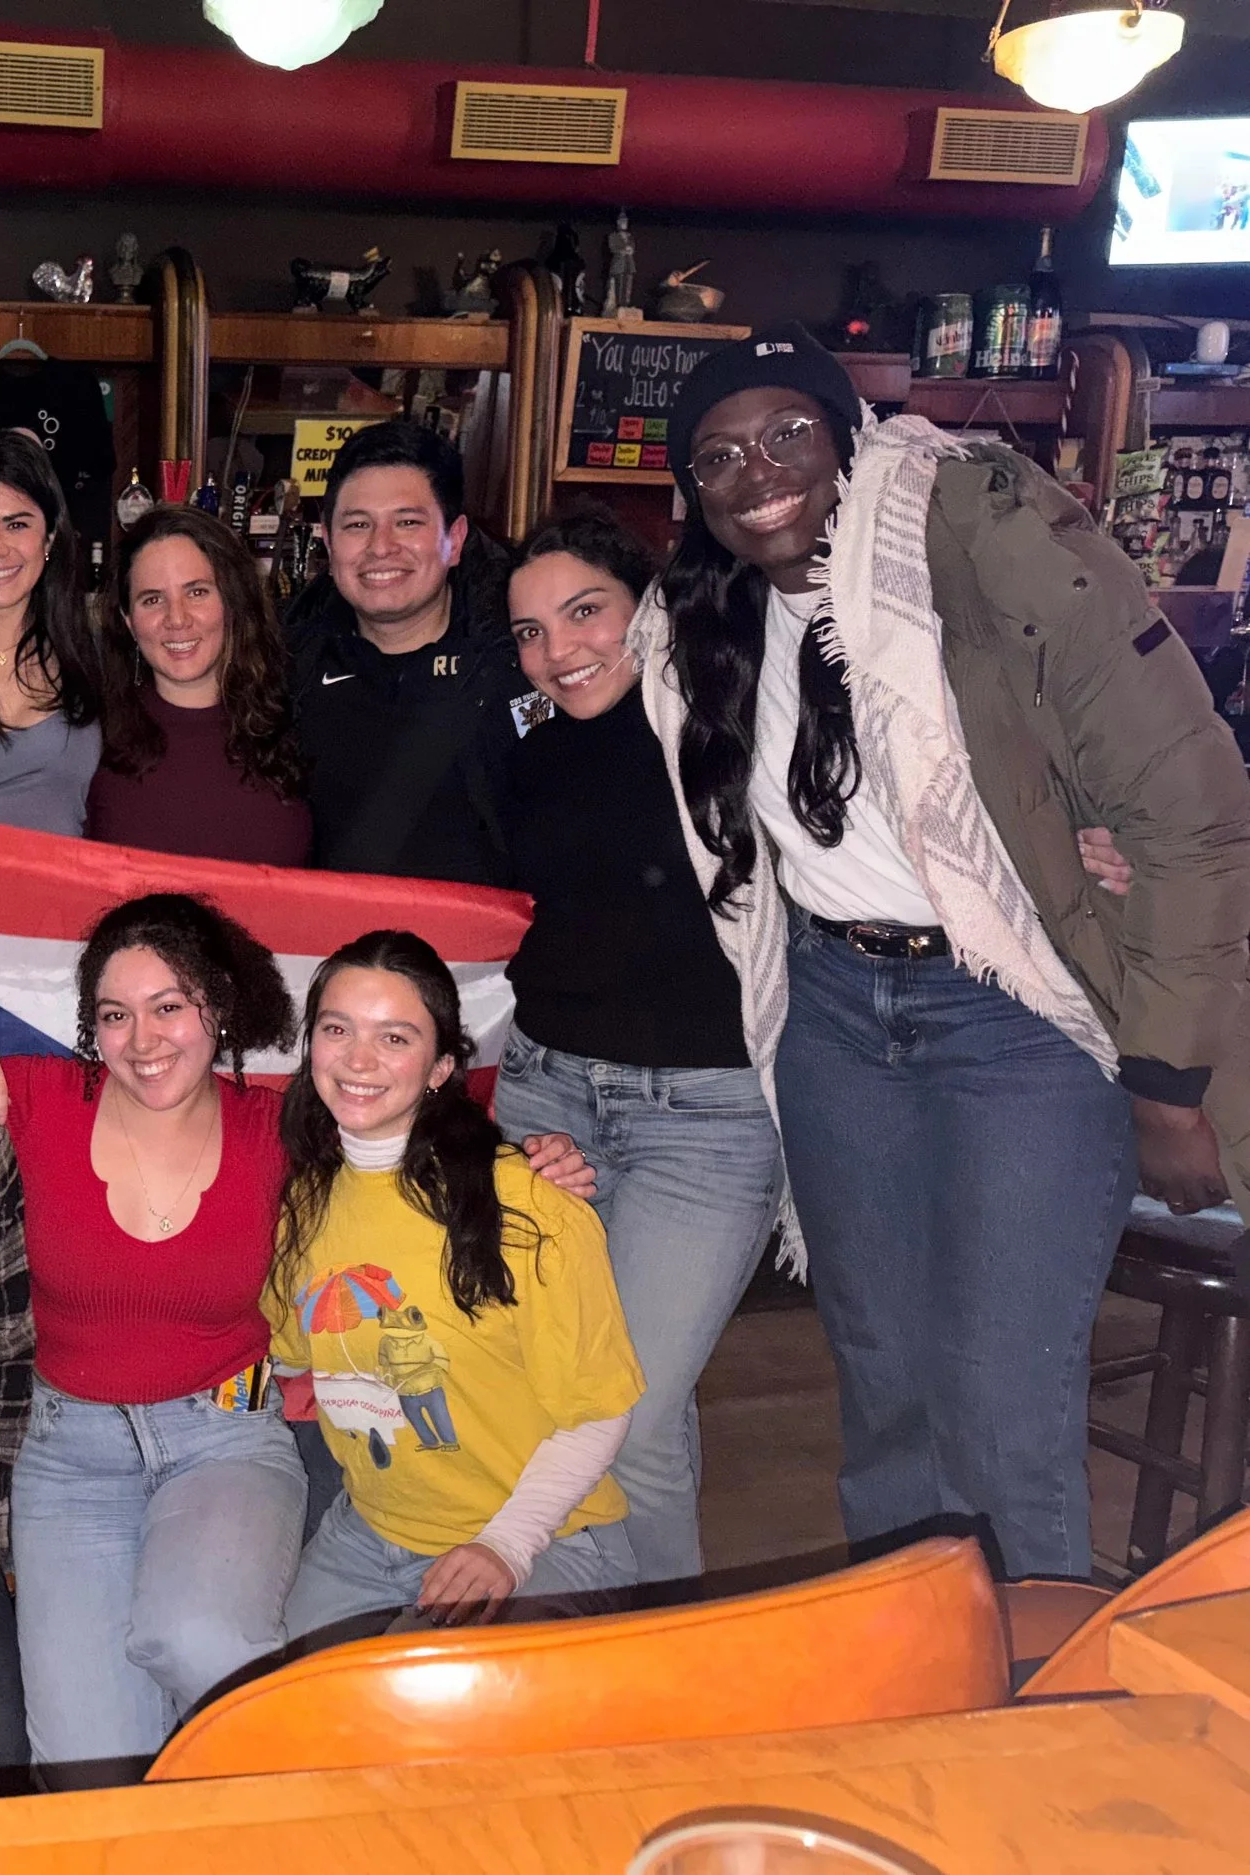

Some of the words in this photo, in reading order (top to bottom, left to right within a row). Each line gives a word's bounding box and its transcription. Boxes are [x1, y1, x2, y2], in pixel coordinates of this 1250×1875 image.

[630, 344, 673, 379] guys
[975, 350, 1031, 368] Heine
[326, 426, 353, 441] $10
[232, 484, 247, 533] ORIGI
